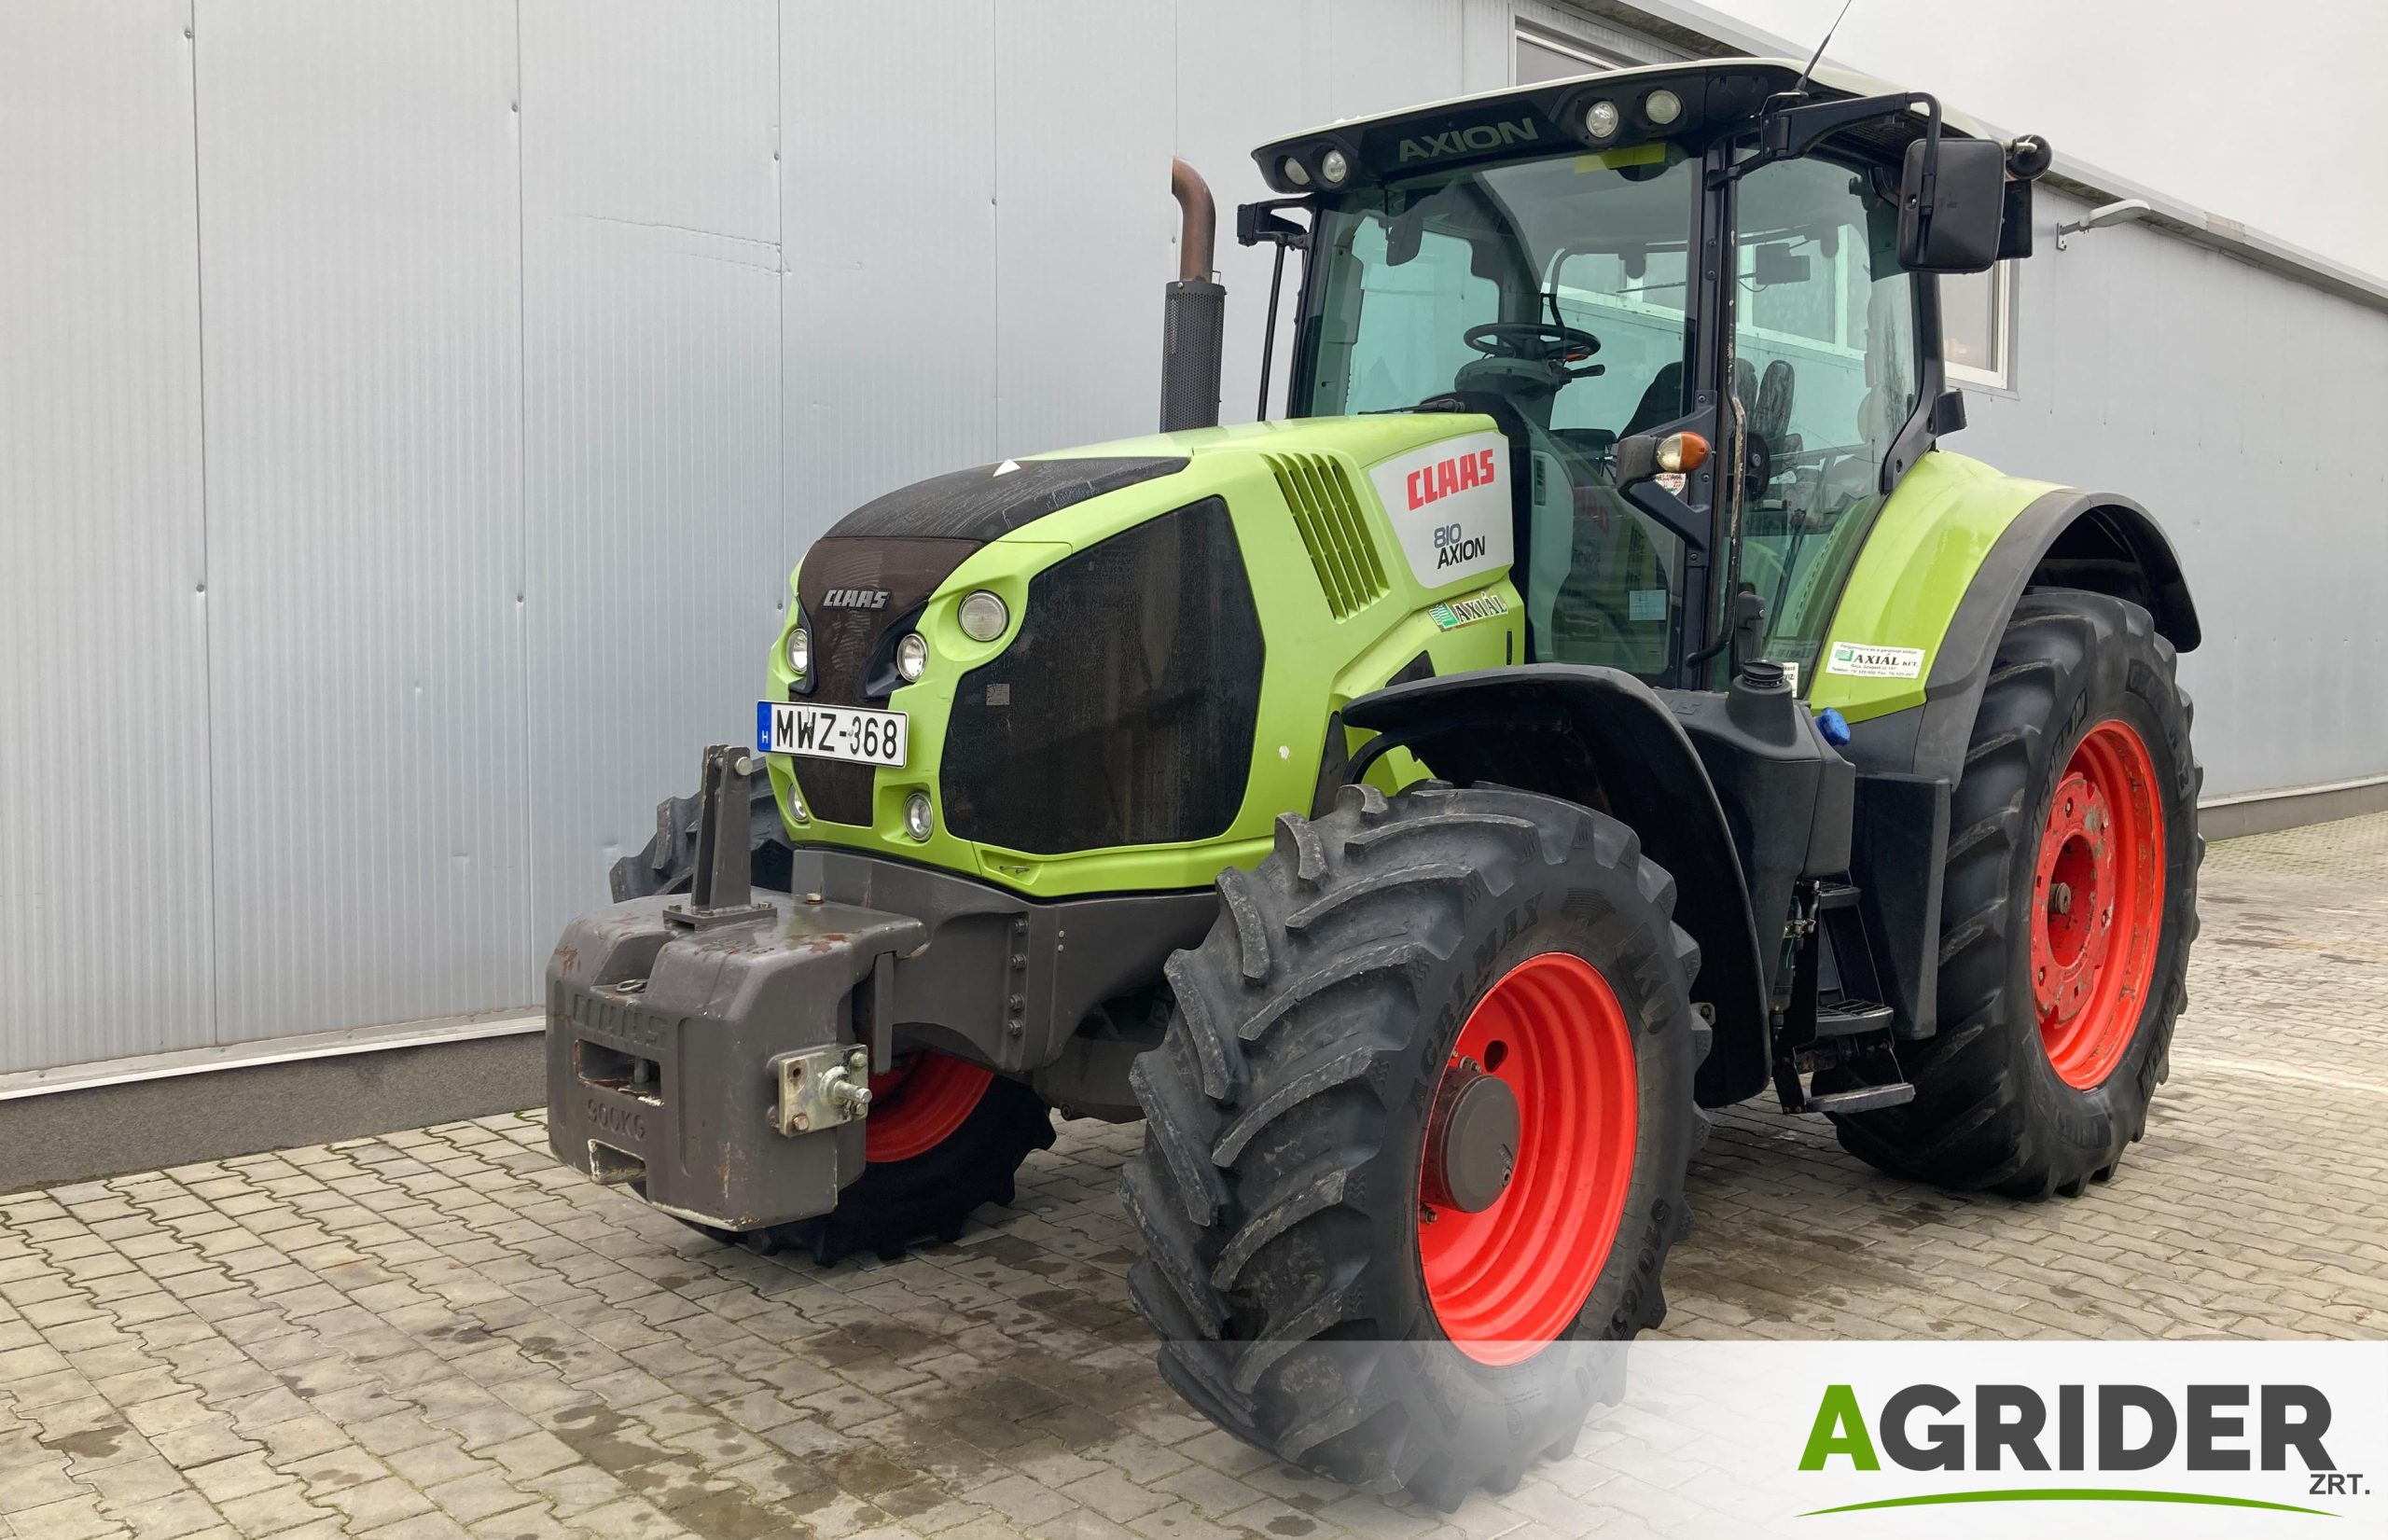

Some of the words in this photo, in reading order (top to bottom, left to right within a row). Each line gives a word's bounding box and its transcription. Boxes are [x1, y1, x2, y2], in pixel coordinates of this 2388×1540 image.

[1399, 118, 1539, 162] AXION
[1407, 449, 1494, 511] CLAAS
[1434, 522, 1462, 548] 810
[1437, 535, 1486, 570] AXION
[823, 590, 889, 609] CLAAS
[1455, 591, 1508, 624] AXIÁL
[1853, 653, 1900, 666] AXIÁL
[761, 730, 769, 744] H
[776, 710, 897, 759] MWZ-368
[587, 1098, 646, 1142] 900KG
